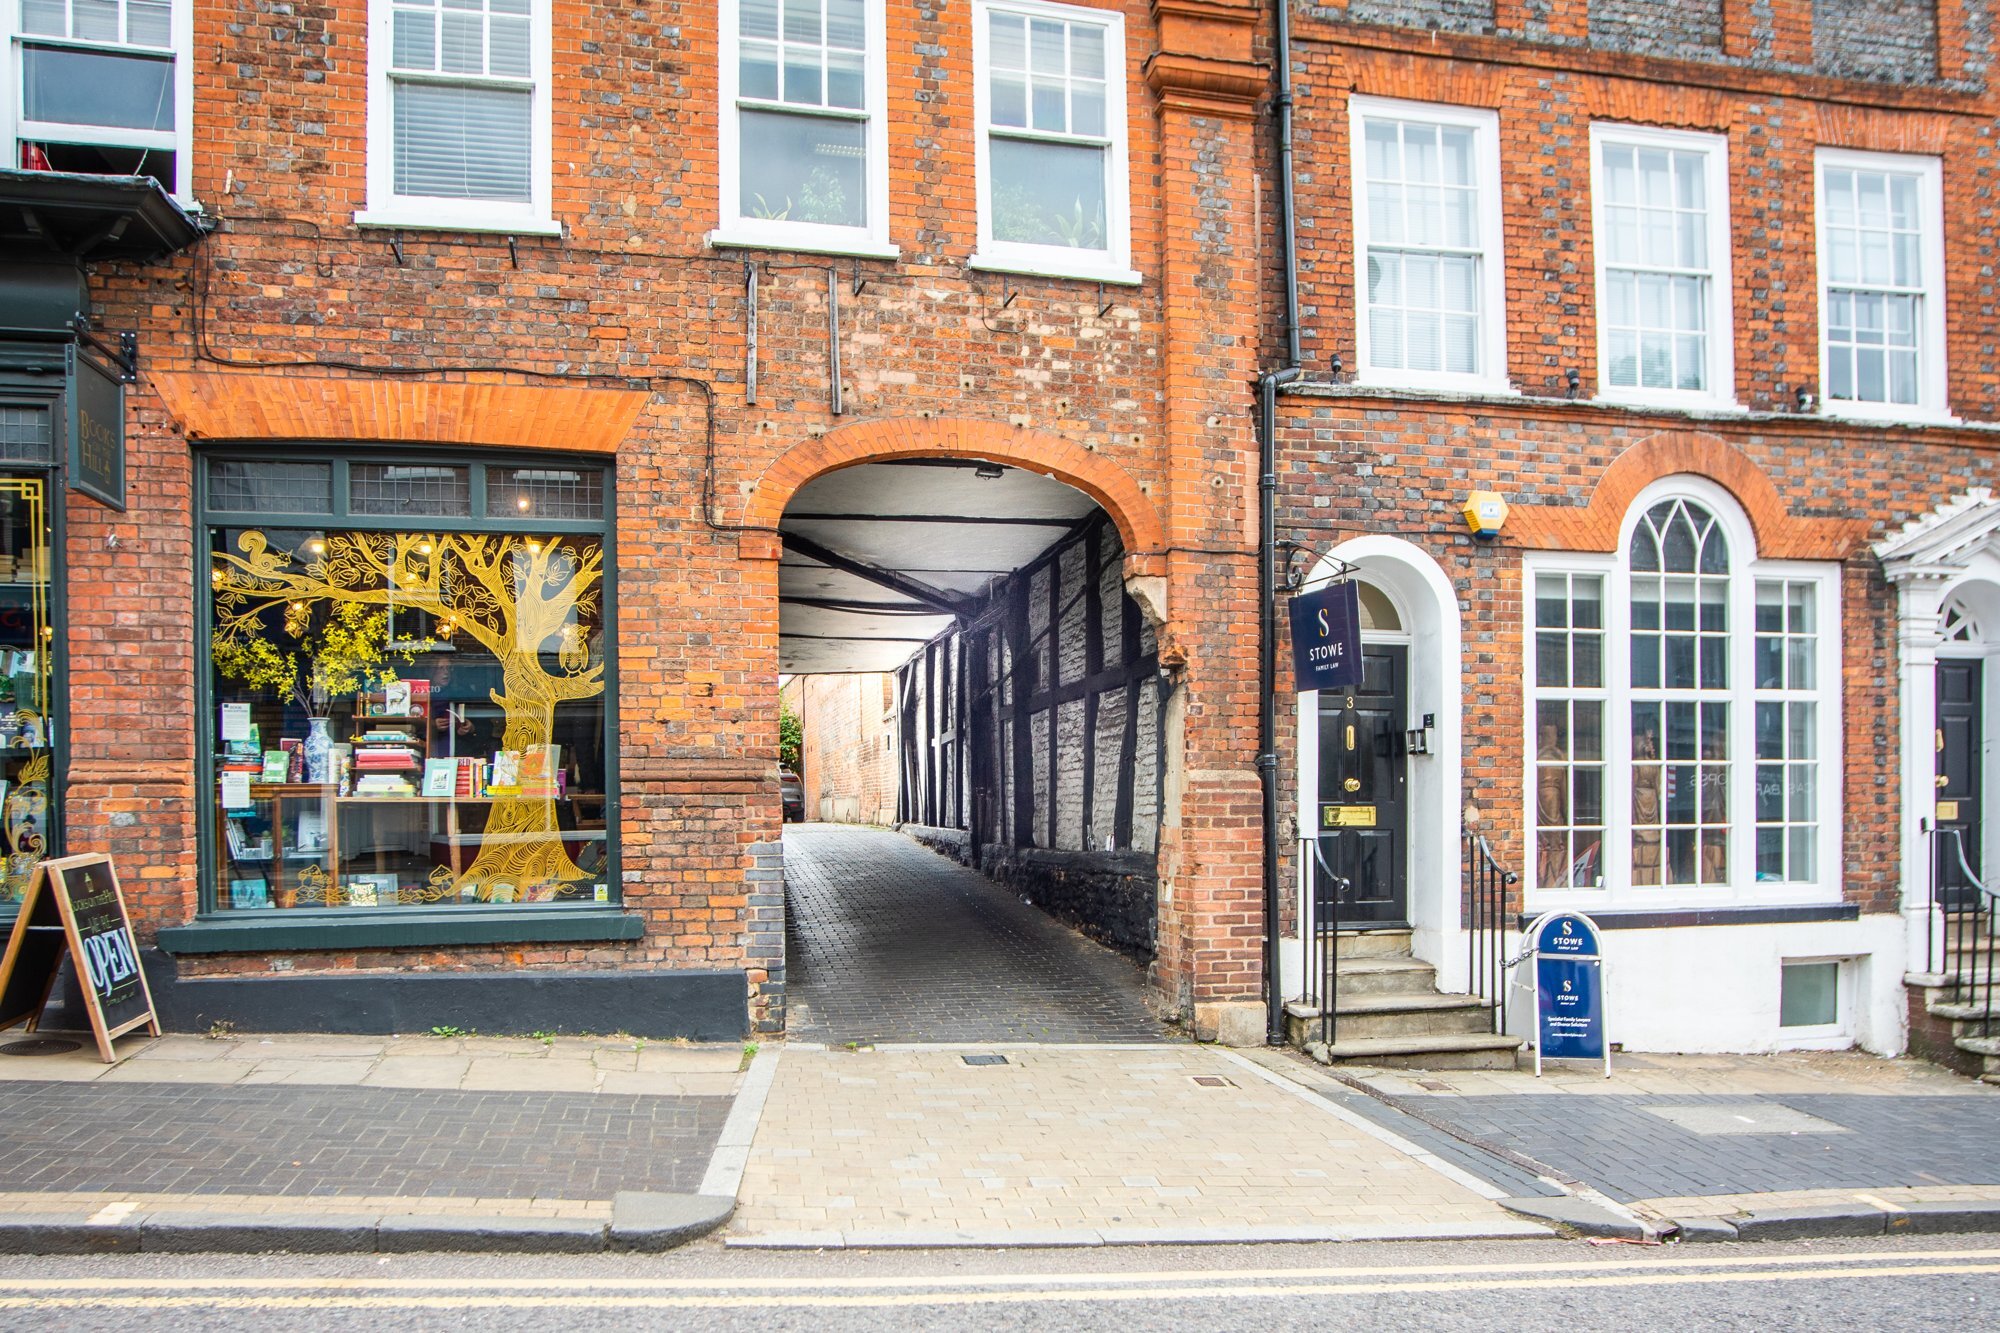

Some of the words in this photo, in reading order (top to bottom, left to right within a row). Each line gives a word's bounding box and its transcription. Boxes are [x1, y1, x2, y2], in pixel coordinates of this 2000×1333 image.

[80, 410, 115, 449] BOOKS
[82, 440, 104, 475] HILL
[1310, 642, 1343, 661] STOWE
[1316, 664, 1329, 672] FAMILY
[1330, 662, 1339, 670] LAW
[1346, 696, 1354, 708] 3
[1553, 938, 1583, 946] STOWE
[84, 926, 137, 996] OPEN
[1557, 994, 1578, 1002] STOWE
